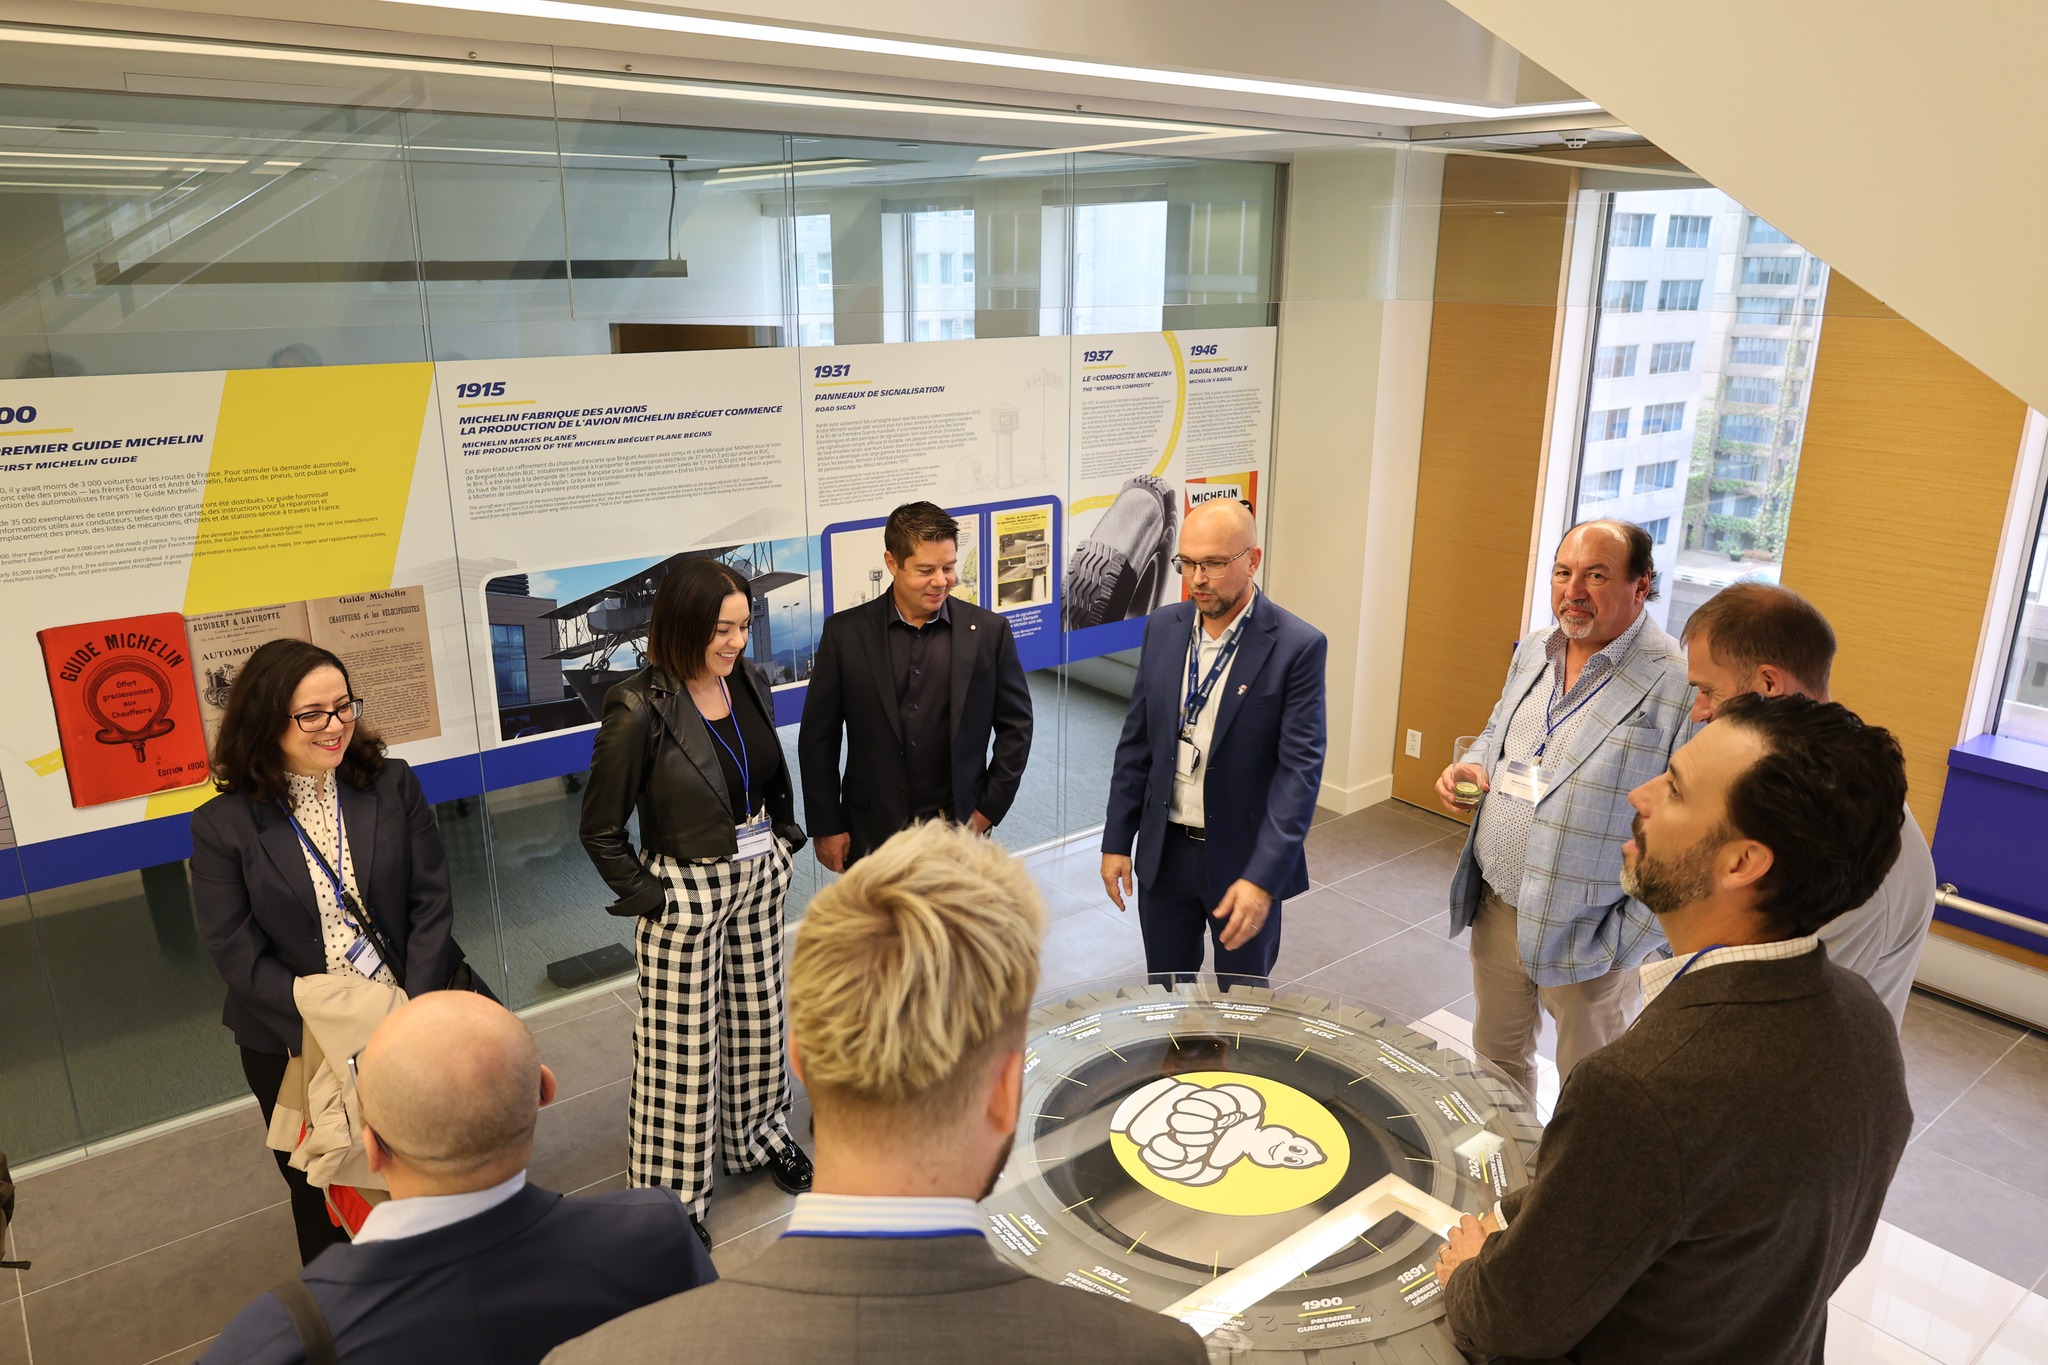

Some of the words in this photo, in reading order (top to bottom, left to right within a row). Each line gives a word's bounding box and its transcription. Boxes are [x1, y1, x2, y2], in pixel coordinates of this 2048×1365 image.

[1082, 350, 1113, 362] 1937
[1189, 344, 1218, 356] 1946
[814, 364, 850, 379] 1931
[455, 381, 506, 398] 1915
[814, 391, 865, 401] PANNEAUX
[867, 390, 879, 398] DE
[880, 386, 945, 397] SIGNALISATION
[459, 413, 519, 425] MICHELIN
[521, 409, 580, 421] FABRIQUE
[582, 408, 603, 417] DES
[605, 405, 647, 415] AVIONS
[460, 427, 476, 436] LA
[479, 421, 556, 434] PRODUCTION
[558, 420, 573, 428] DE
[575, 417, 621, 427] L'AVION
[622, 413, 675, 424] MICHELIN
[677, 409, 723, 420] BRÉGUET
[725, 406, 783, 417] COMMENCE
[0, 443, 68, 456] REMIER
[72, 439, 122, 452] GUIDE
[125, 434, 204, 448] MICHELIN
[462, 440, 507, 449] MICHELIN
[509, 437, 541, 445] MAKES
[543, 434, 577, 442] PLANES
[482, 445, 541, 455] PRODUCTION
[574, 439, 615, 447] MICHELIN
[618, 435, 654, 444] BRÉGUET
[656, 433, 682, 441] PLANE
[35, 459, 98, 470] MICHELIN
[101, 456, 138, 465] GUIDE
[43, 481, 67, 491] moins
[87, 479, 102, 487] 000
[103, 478, 134, 486] voitures
[161, 473, 185, 481] routes
[197, 470, 223, 478] France.
[242, 467, 271, 475] stimuler
[279, 464, 311, 472] demande
[312, 461, 349, 469] automobile
[41, 496, 98, 506] automobilistes
[99, 493, 130, 501] français
[143, 489, 165, 498] Guide
[167, 486, 199, 496] Michelin.
[1192, 488, 1238, 504] MICHELIN
[3, 576, 34, 584] mechanics
[58, 570, 77, 578] hotels,
[91, 567, 108, 575] petrol
[132, 562, 163, 570] throughout
[339, 595, 365, 604] Guide
[370, 590, 405, 600] Michelin
[193, 619, 229, 633] AUDIBERT
[241, 612, 280, 625] LAVIROTTE
[329, 613, 361, 625] CHAUFFEURS
[364, 612, 369, 620] et
[350, 626, 405, 639] AVANT-PROPOS
[60, 642, 101, 682] GUIDE
[104, 633, 185, 668] MICHELIN
[201, 643, 262, 661] AUTOMOB
[102, 687, 154, 702] gracieusement
[111, 707, 152, 719] Chauffeurs
[187, 760, 205, 771] 1900
[1304, 1027, 1336, 1039] 2014
[1377, 1057, 1407, 1073] 2014
[1435, 1100, 1459, 1121] 2022
[1490, 1162, 1502, 1197] PRODUCTION
[996, 1214, 1022, 1237] PREMIER
[1019, 1235, 1037, 1252] PNEU
[1020, 1214, 1048, 1235] 1937
[988, 1216, 1006, 1229] AVEC
[1003, 1227, 1032, 1256] CARCASSE
[991, 1226, 1001, 1234] EN
[998, 1232, 1017, 1250] ACIER
[1092, 1265, 1128, 1285] 1931
[1397, 1264, 1428, 1285] 1891
[1066, 1272, 1113, 1295] INVENTION
[1112, 1293, 1132, 1302] DES
[1404, 1282, 1434, 1304] PREMIER
[1302, 1296, 1343, 1311] 1900
[1297, 1323, 1326, 1333] GUIDE
[1327, 1317, 1372, 1329] MICHELIN
[1311, 1314, 1353, 1325] PREMIER
